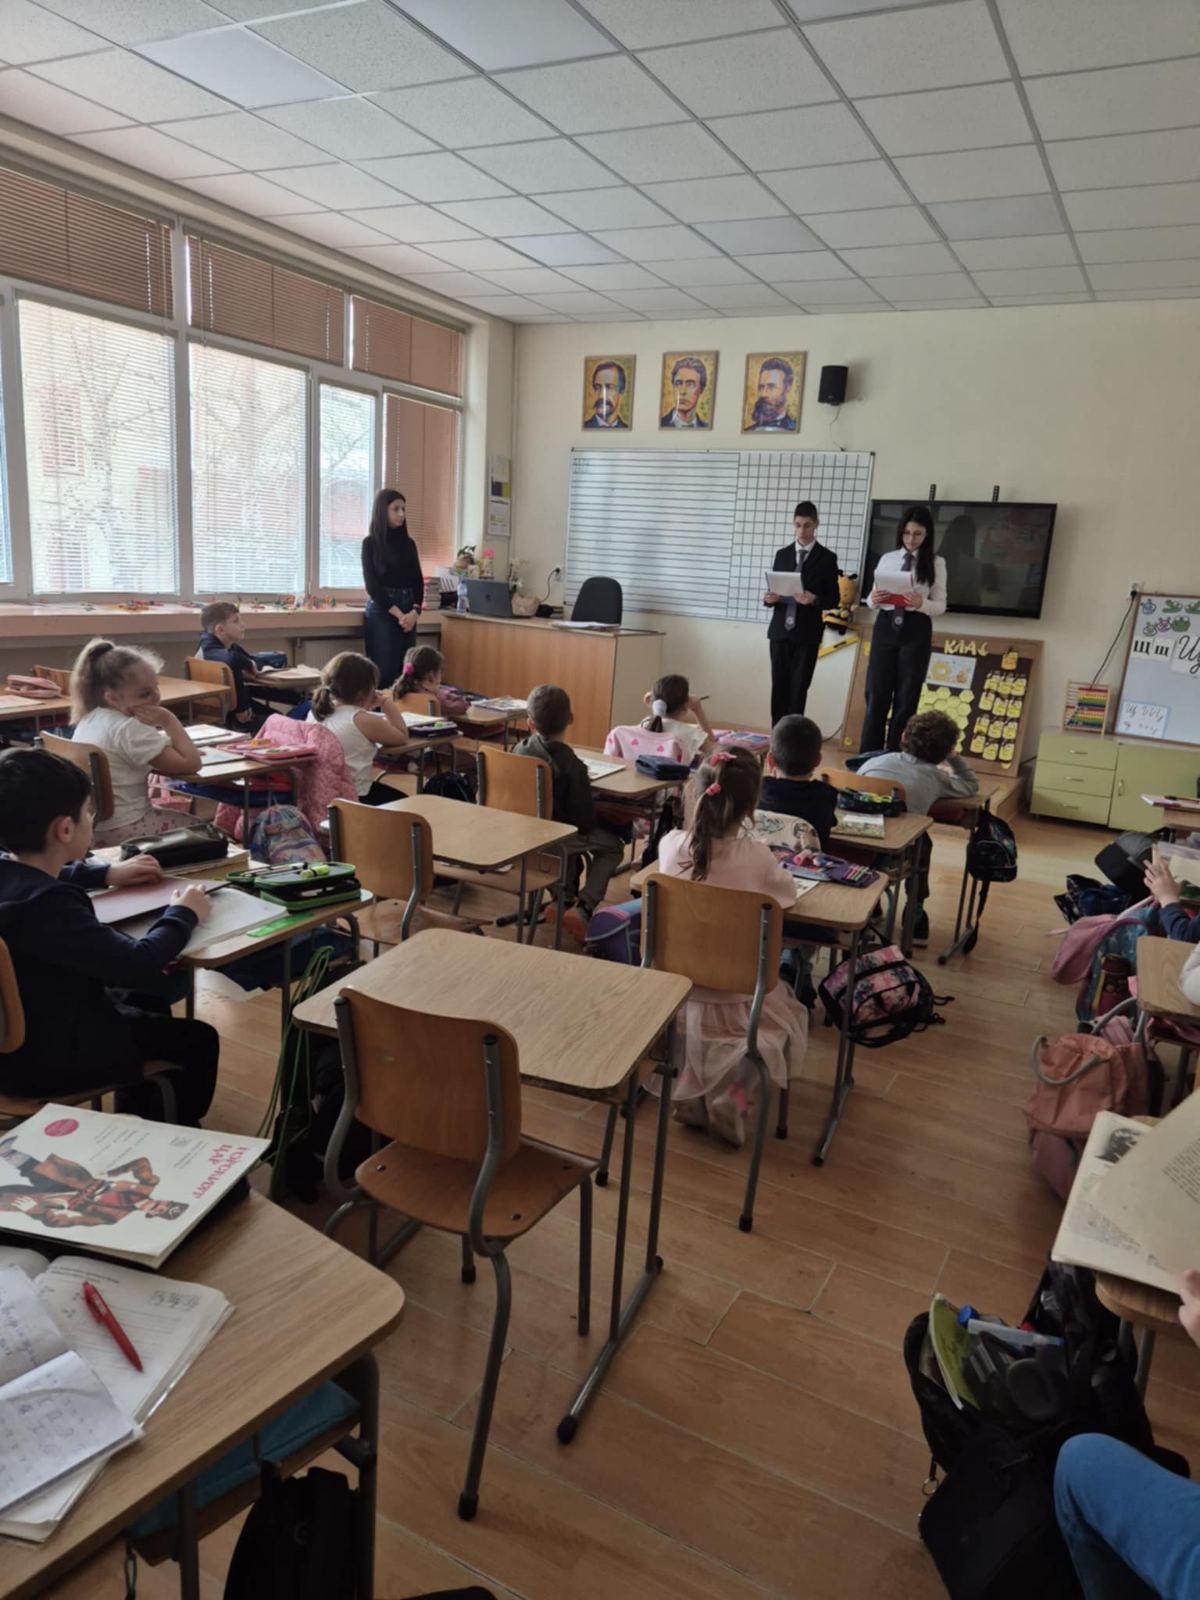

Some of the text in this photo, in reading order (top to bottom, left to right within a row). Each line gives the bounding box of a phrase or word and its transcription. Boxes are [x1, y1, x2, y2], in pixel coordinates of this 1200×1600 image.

[943, 639, 989, 656] КЛАС
[1133, 639, 1150, 656] Щ
[208, 1143, 232, 1165] ЦАР
[192, 1146, 248, 1199] ГОРСКИЯТ
